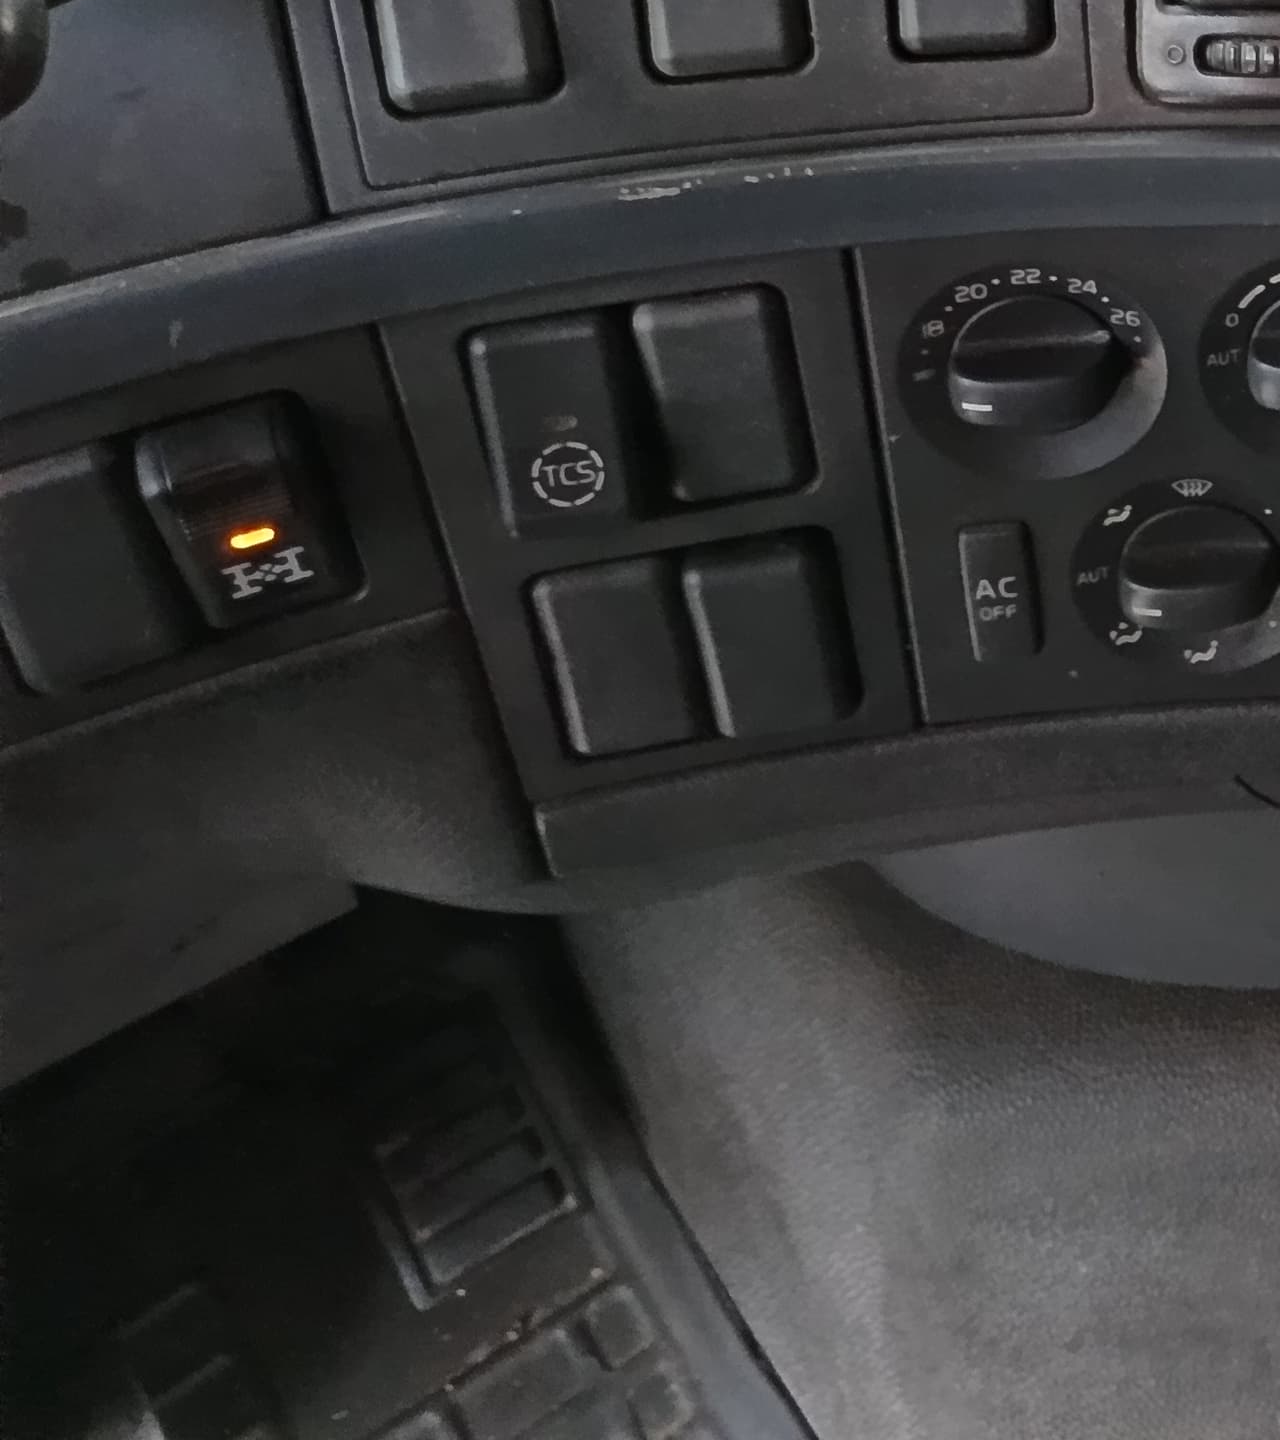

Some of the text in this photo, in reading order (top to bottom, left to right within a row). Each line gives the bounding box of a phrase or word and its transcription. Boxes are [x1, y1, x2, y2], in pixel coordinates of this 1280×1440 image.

[1009, 268, 1041, 285] 22
[953, 283, 988, 303] 20
[1067, 278, 1098, 295] 24
[1110, 308, 1141, 327] 26
[1206, 348, 1241, 366] AUT
[541, 460, 596, 487] TCS
[1076, 566, 1111, 585] AUT
[976, 576, 1018, 600] AC
[979, 604, 1017, 621] OFF
